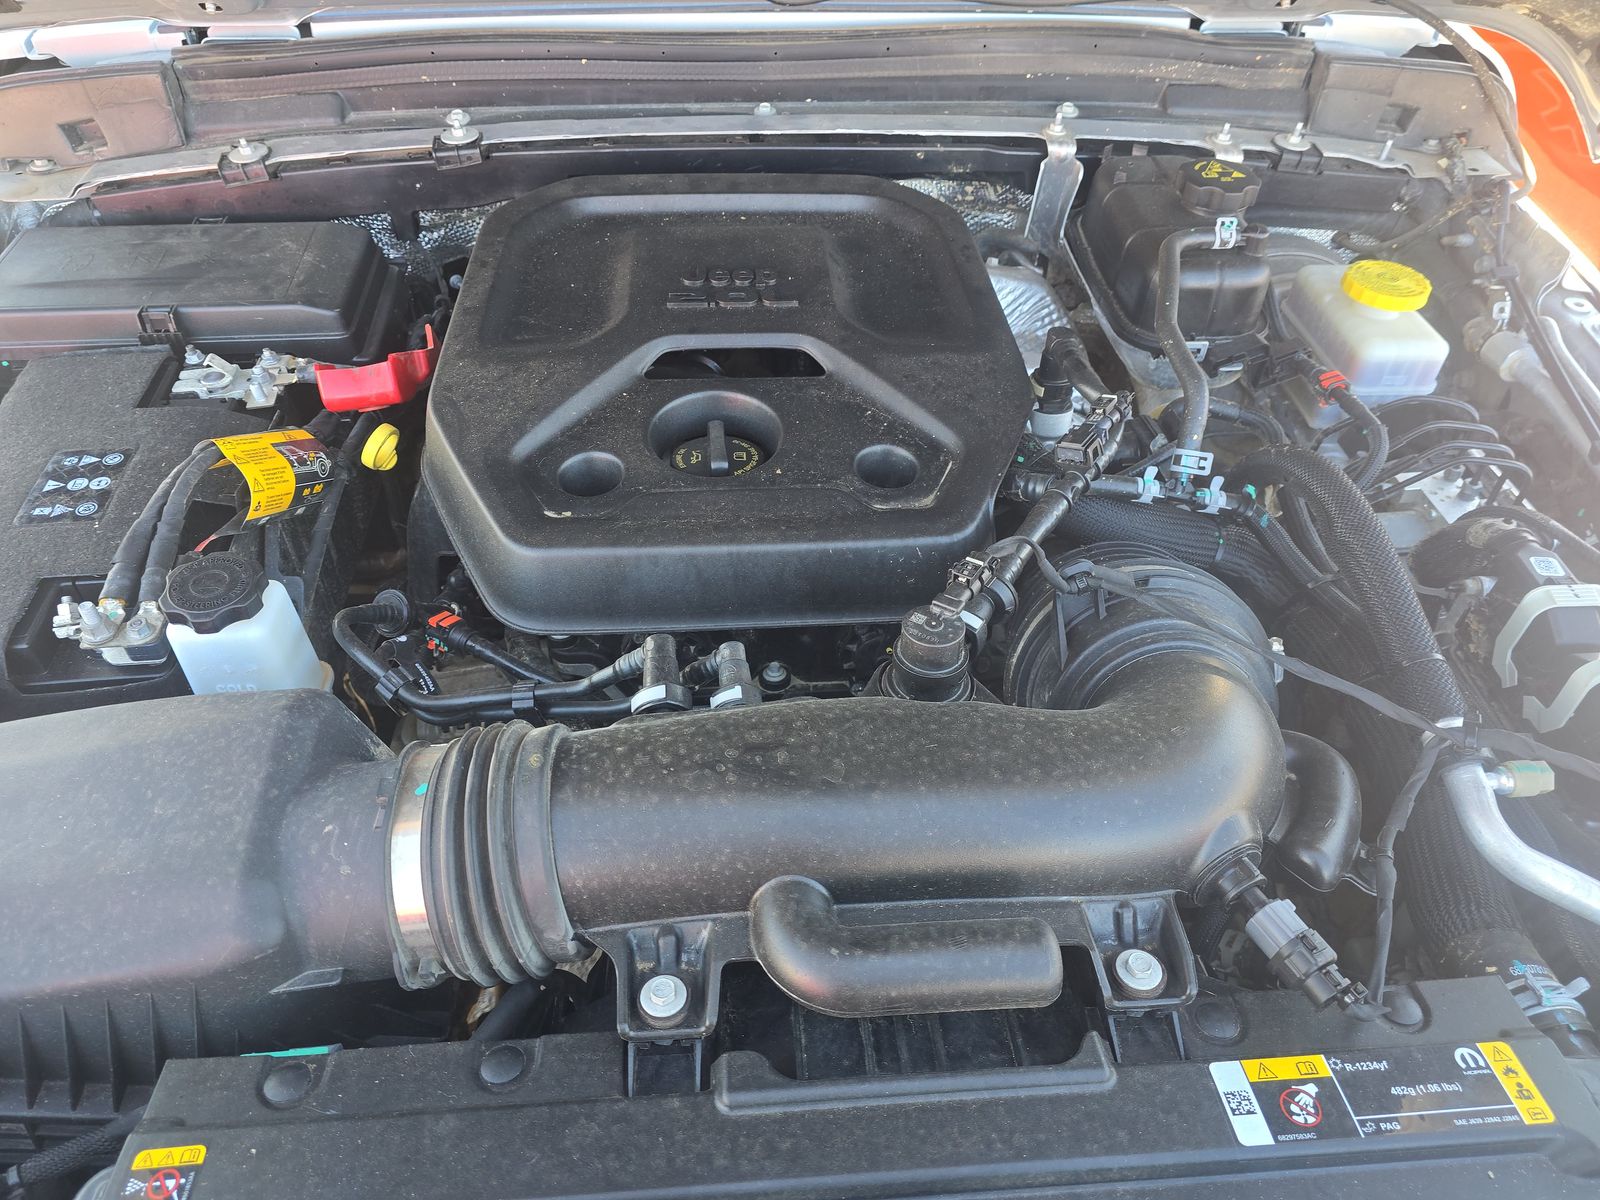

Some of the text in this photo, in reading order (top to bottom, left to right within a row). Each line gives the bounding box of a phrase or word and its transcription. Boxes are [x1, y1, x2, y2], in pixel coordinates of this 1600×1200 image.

[681, 265, 777, 288] Jeep
[185, 596, 228, 608] STEERING
[1344, 1060, 1389, 1072] R-1234yf
[1390, 1081, 1462, 1096] 482g (1.06 lbs)
[1380, 1121, 1401, 1131] PAG
